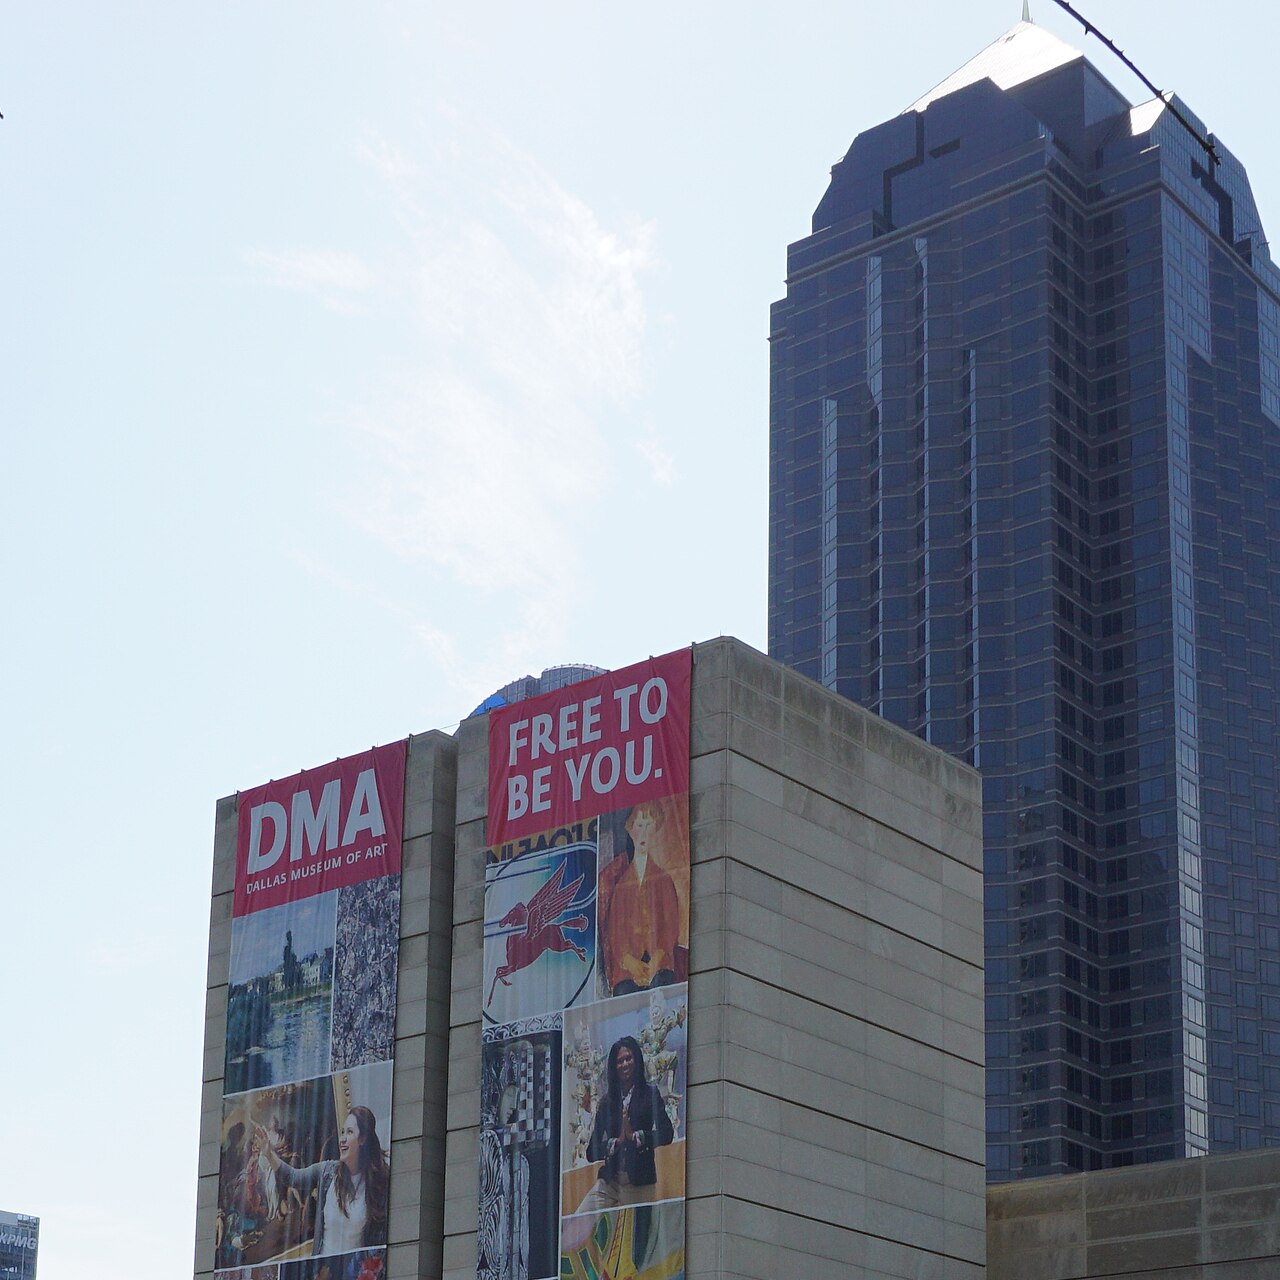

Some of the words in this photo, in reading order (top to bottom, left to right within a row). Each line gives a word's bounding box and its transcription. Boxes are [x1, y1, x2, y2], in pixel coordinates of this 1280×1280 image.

[508, 695, 602, 767] FREE
[613, 676, 668, 733] TO
[247, 768, 387, 875] DMA
[507, 764, 552, 821] BE
[564, 734, 663, 802] YOU.
[246, 872, 287, 895] DALLAS
[290, 855, 342, 882] MUSEUM
[346, 849, 362, 865] OF
[364, 843, 388, 861] ART
